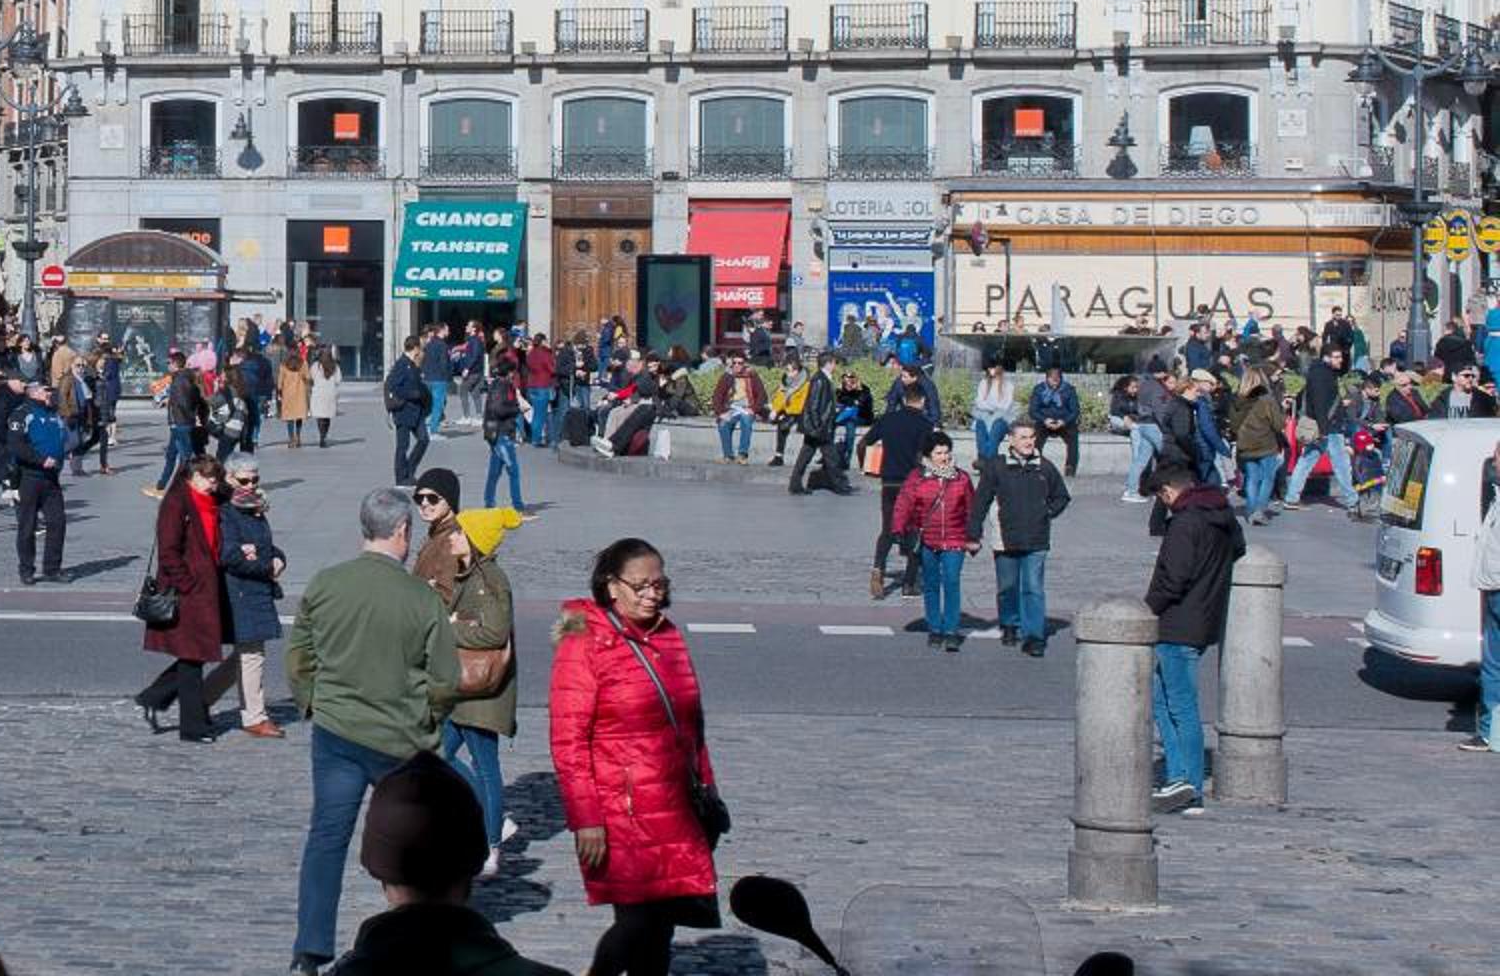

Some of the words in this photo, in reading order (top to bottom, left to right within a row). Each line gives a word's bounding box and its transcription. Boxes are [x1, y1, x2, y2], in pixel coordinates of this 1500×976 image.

[415, 212, 514, 227] CHANGE
[1016, 206, 1092, 224] CASA
[1113, 207, 1149, 224] DE
[1170, 207, 1260, 224] DIEGO
[410, 240, 509, 254] TRANSFER
[405, 267, 505, 282] CAMBIO
[985, 285, 1275, 321] PARAGUAS
